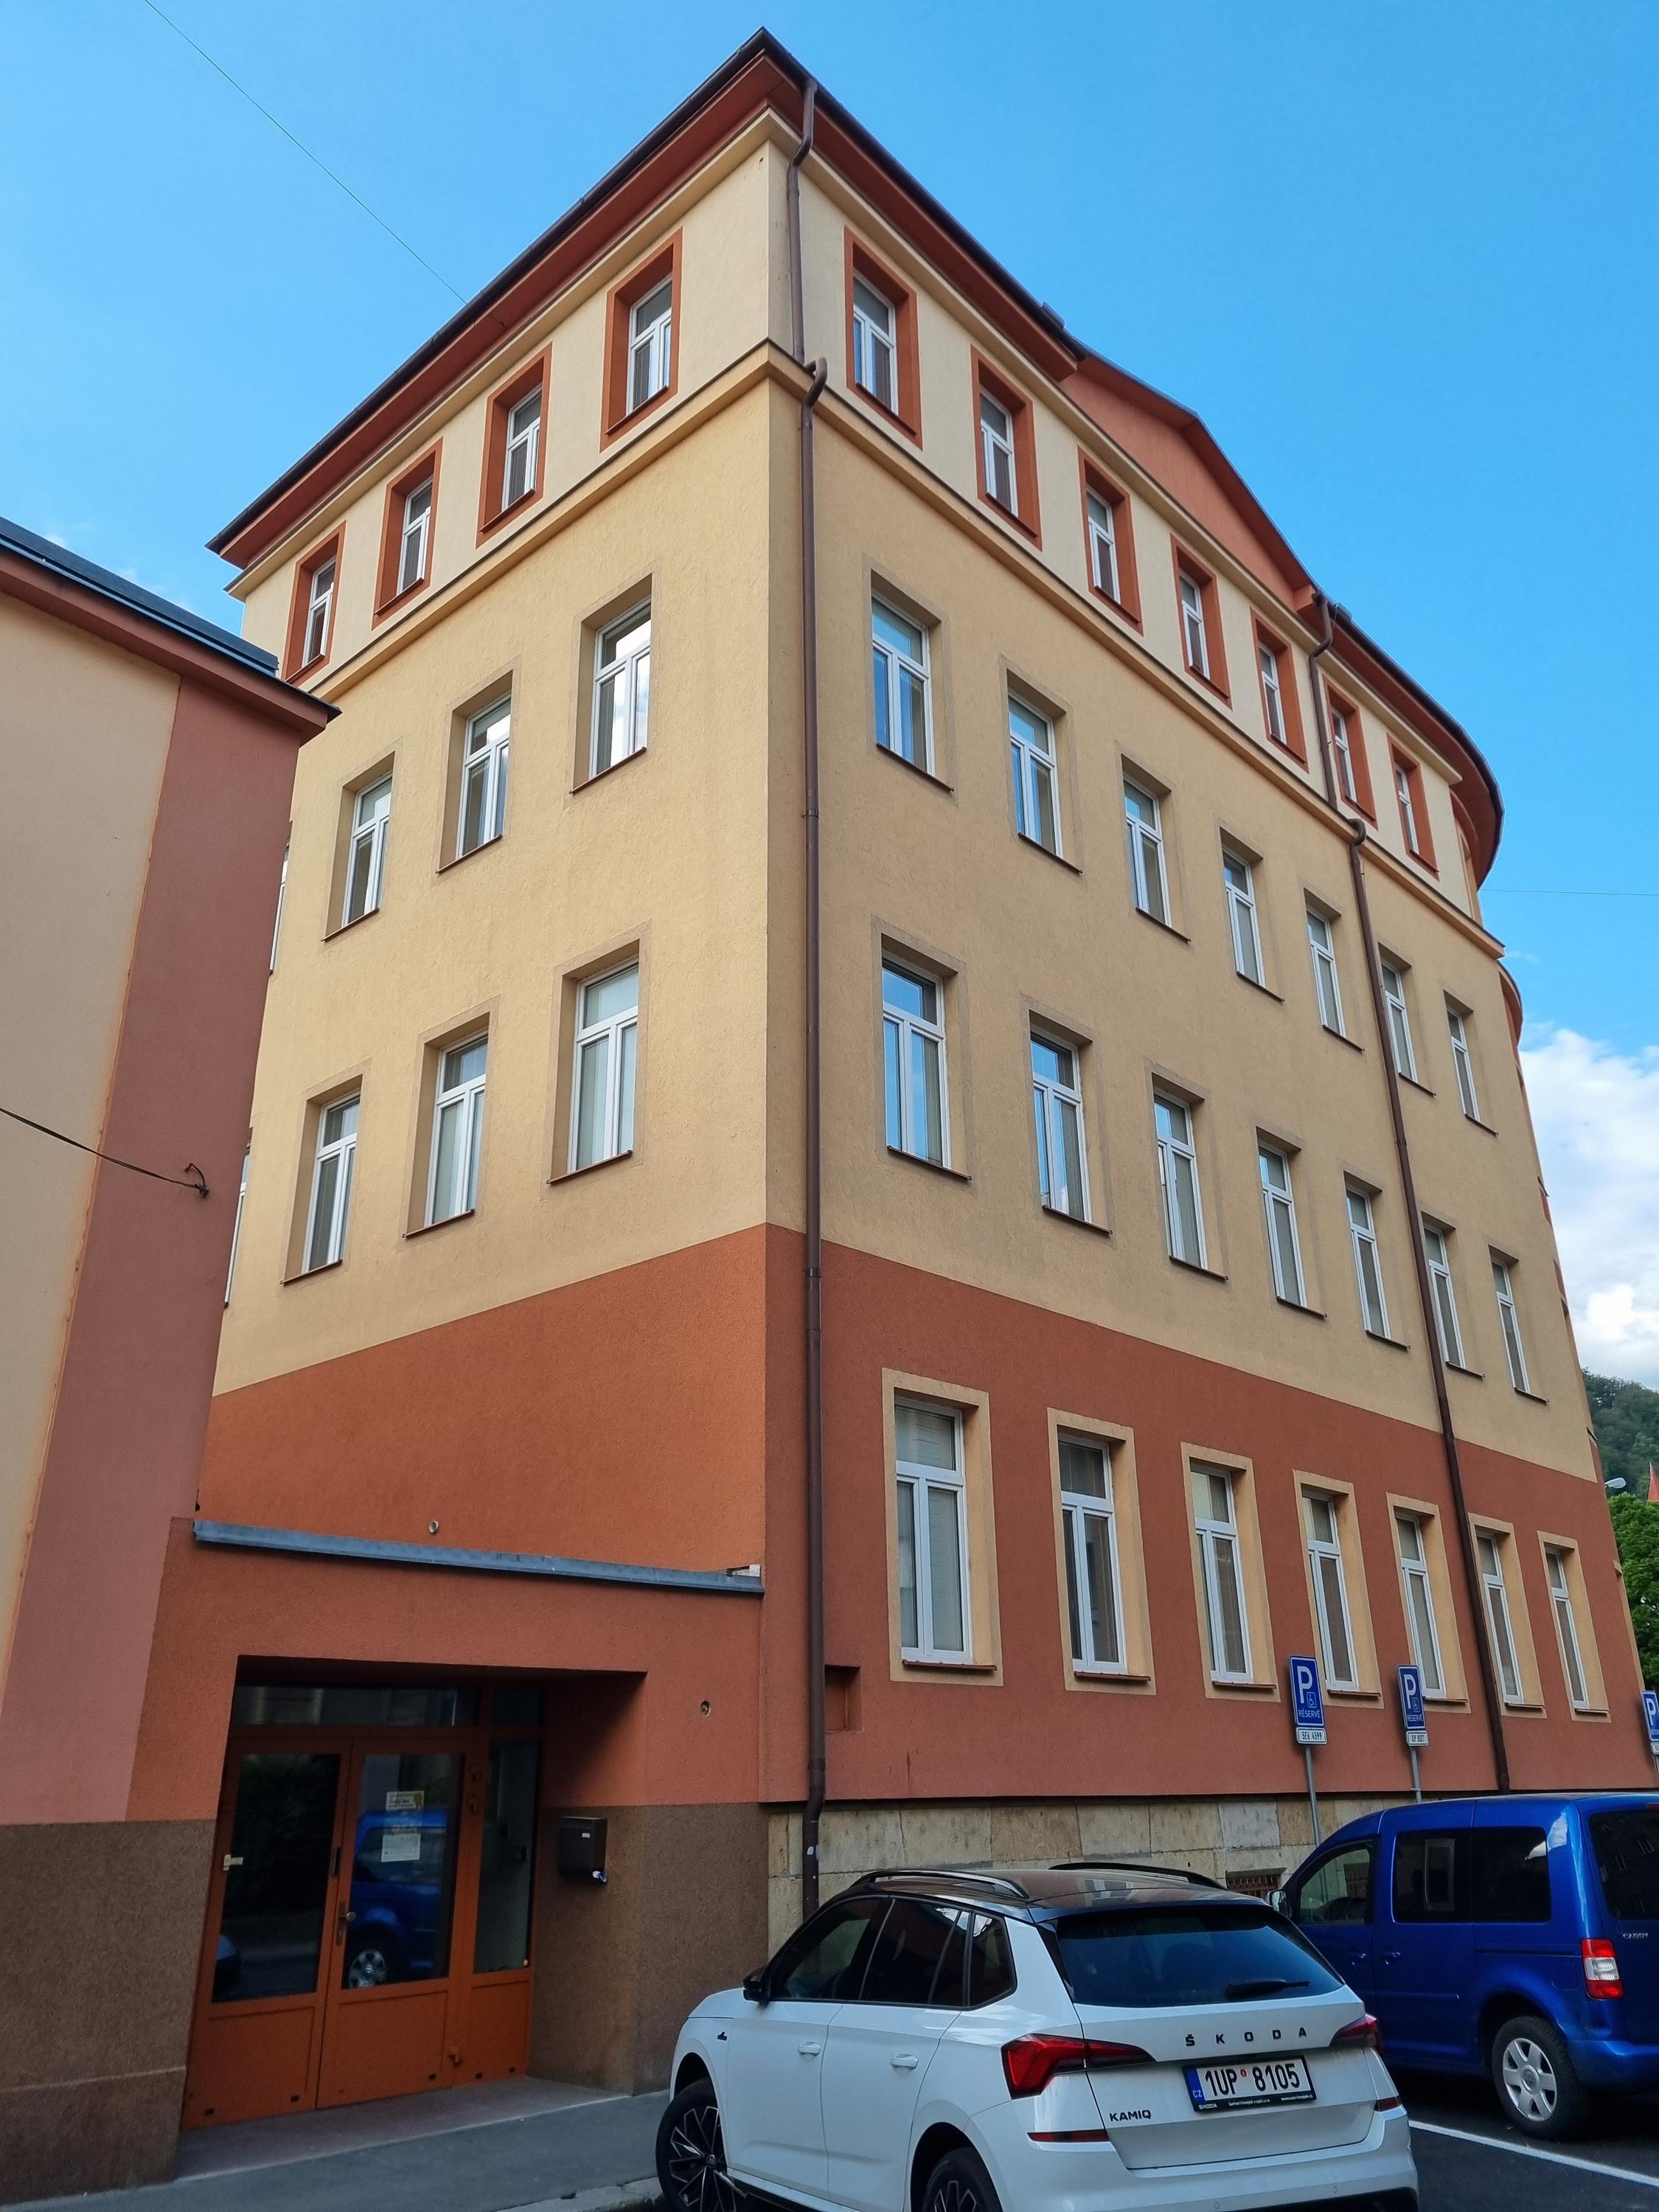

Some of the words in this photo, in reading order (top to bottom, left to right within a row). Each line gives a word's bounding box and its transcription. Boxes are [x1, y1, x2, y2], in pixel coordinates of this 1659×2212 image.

[1296, 1666, 1313, 1704] P
[1403, 1674, 1416, 1709] P
[1646, 1697, 1656, 1726] P
[1185, 2027, 1307, 2047] ŠKODA
[1192, 2090, 1203, 2098] CZ
[1205, 2069, 1237, 2096] 1UP
[1252, 2064, 1300, 2092] 8105
[1109, 2109, 1152, 2123] KAMIQ
